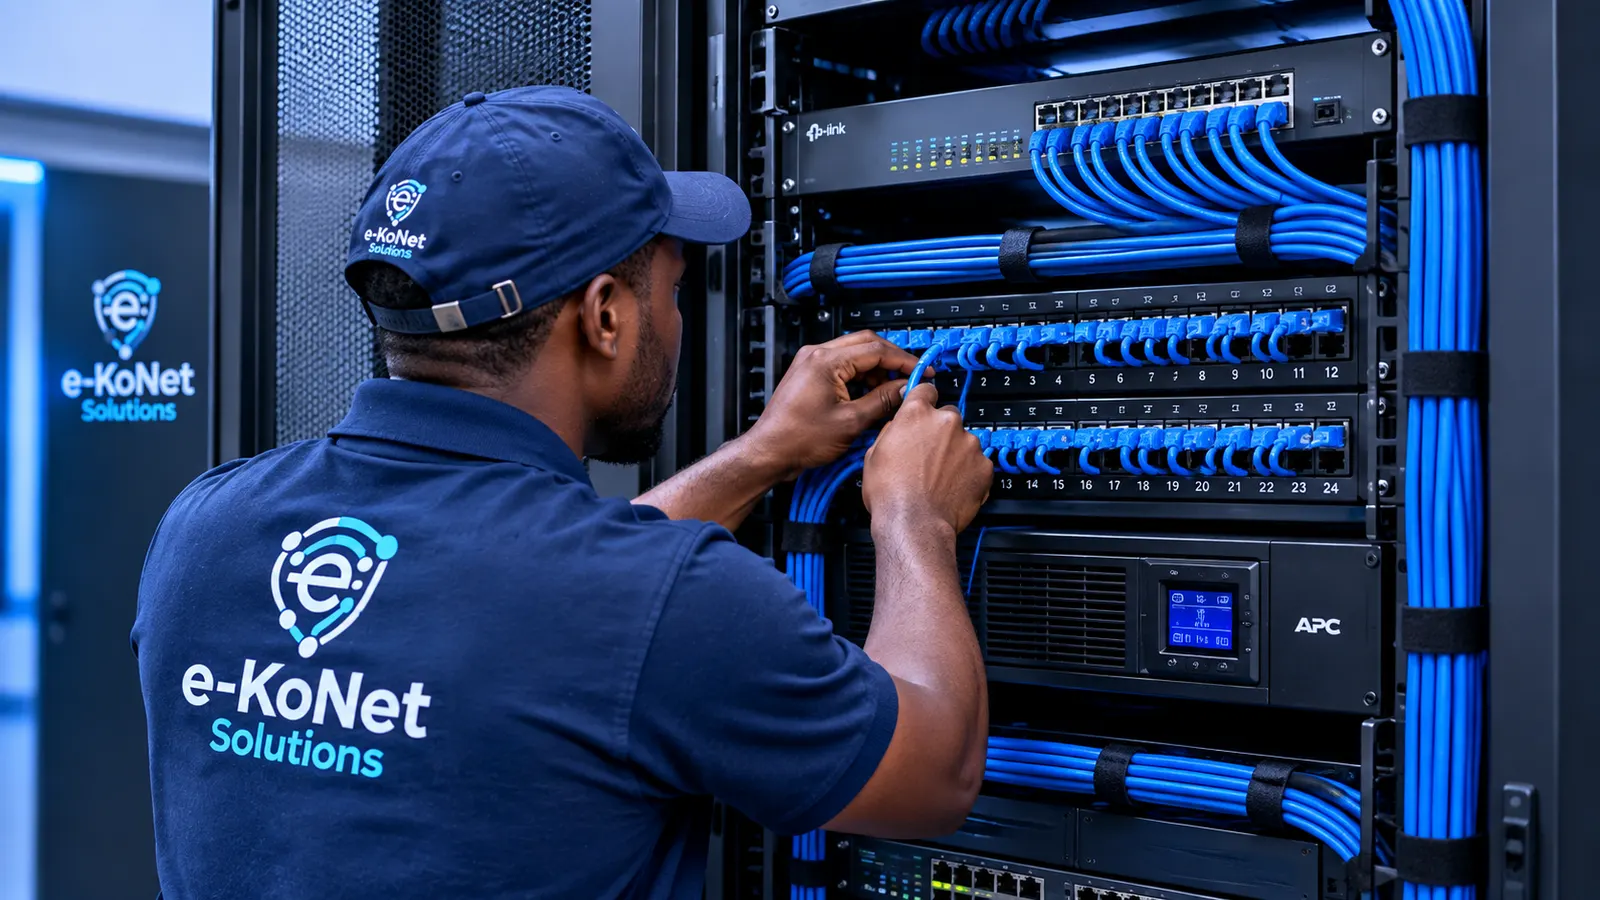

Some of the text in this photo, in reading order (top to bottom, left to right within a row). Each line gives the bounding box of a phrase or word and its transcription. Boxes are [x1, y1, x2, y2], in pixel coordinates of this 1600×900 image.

[364, 226, 427, 249] e-KoNet
[61, 361, 196, 398] e-KoNet
[953, 378, 958, 387] 1
[981, 376, 987, 386] 2
[1004, 376, 1011, 386] 2
[1029, 376, 1036, 386] 3
[1055, 375, 1062, 385] 4
[1116, 373, 1124, 383] 6
[1148, 372, 1155, 382] 7
[1198, 370, 1206, 381] 8
[1231, 369, 1239, 380] 9
[1260, 368, 1274, 379] 10
[1293, 367, 1305, 379] 11
[1324, 366, 1339, 378] 12
[80, 398, 178, 422] Solutions
[1001, 479, 1340, 495] 13 14 15 16 17 18 19 20 21 22 23 24
[1294, 616, 1342, 636] APC
[181, 657, 432, 739] e-KoNet
[208, 717, 385, 778] Solutions
